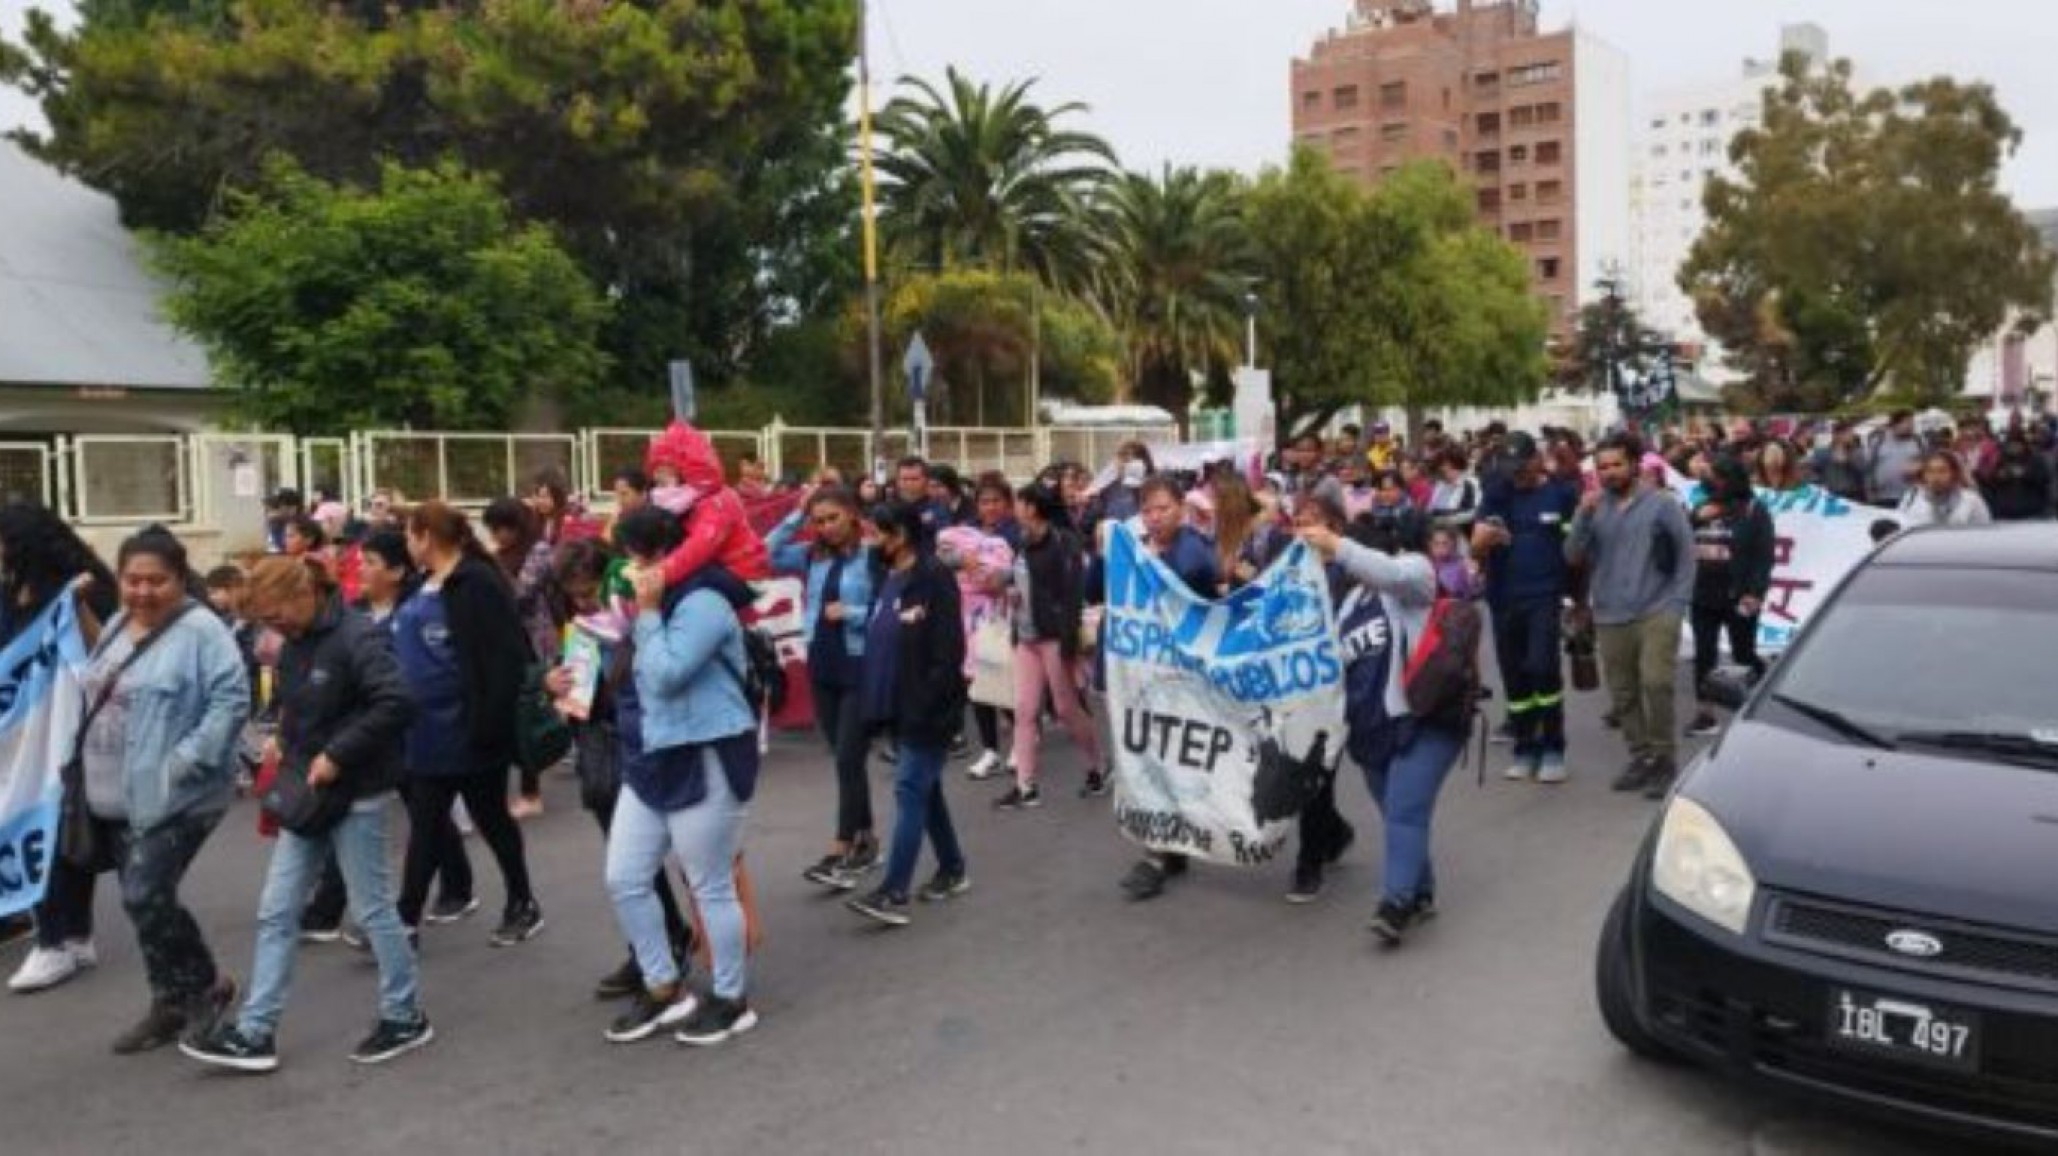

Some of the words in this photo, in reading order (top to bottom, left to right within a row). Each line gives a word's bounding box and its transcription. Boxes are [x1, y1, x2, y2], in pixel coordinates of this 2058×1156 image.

[1123, 707, 1234, 772] UTEP
[1839, 1003, 1893, 1045] IBL
[1912, 1014, 1970, 1057] 497
